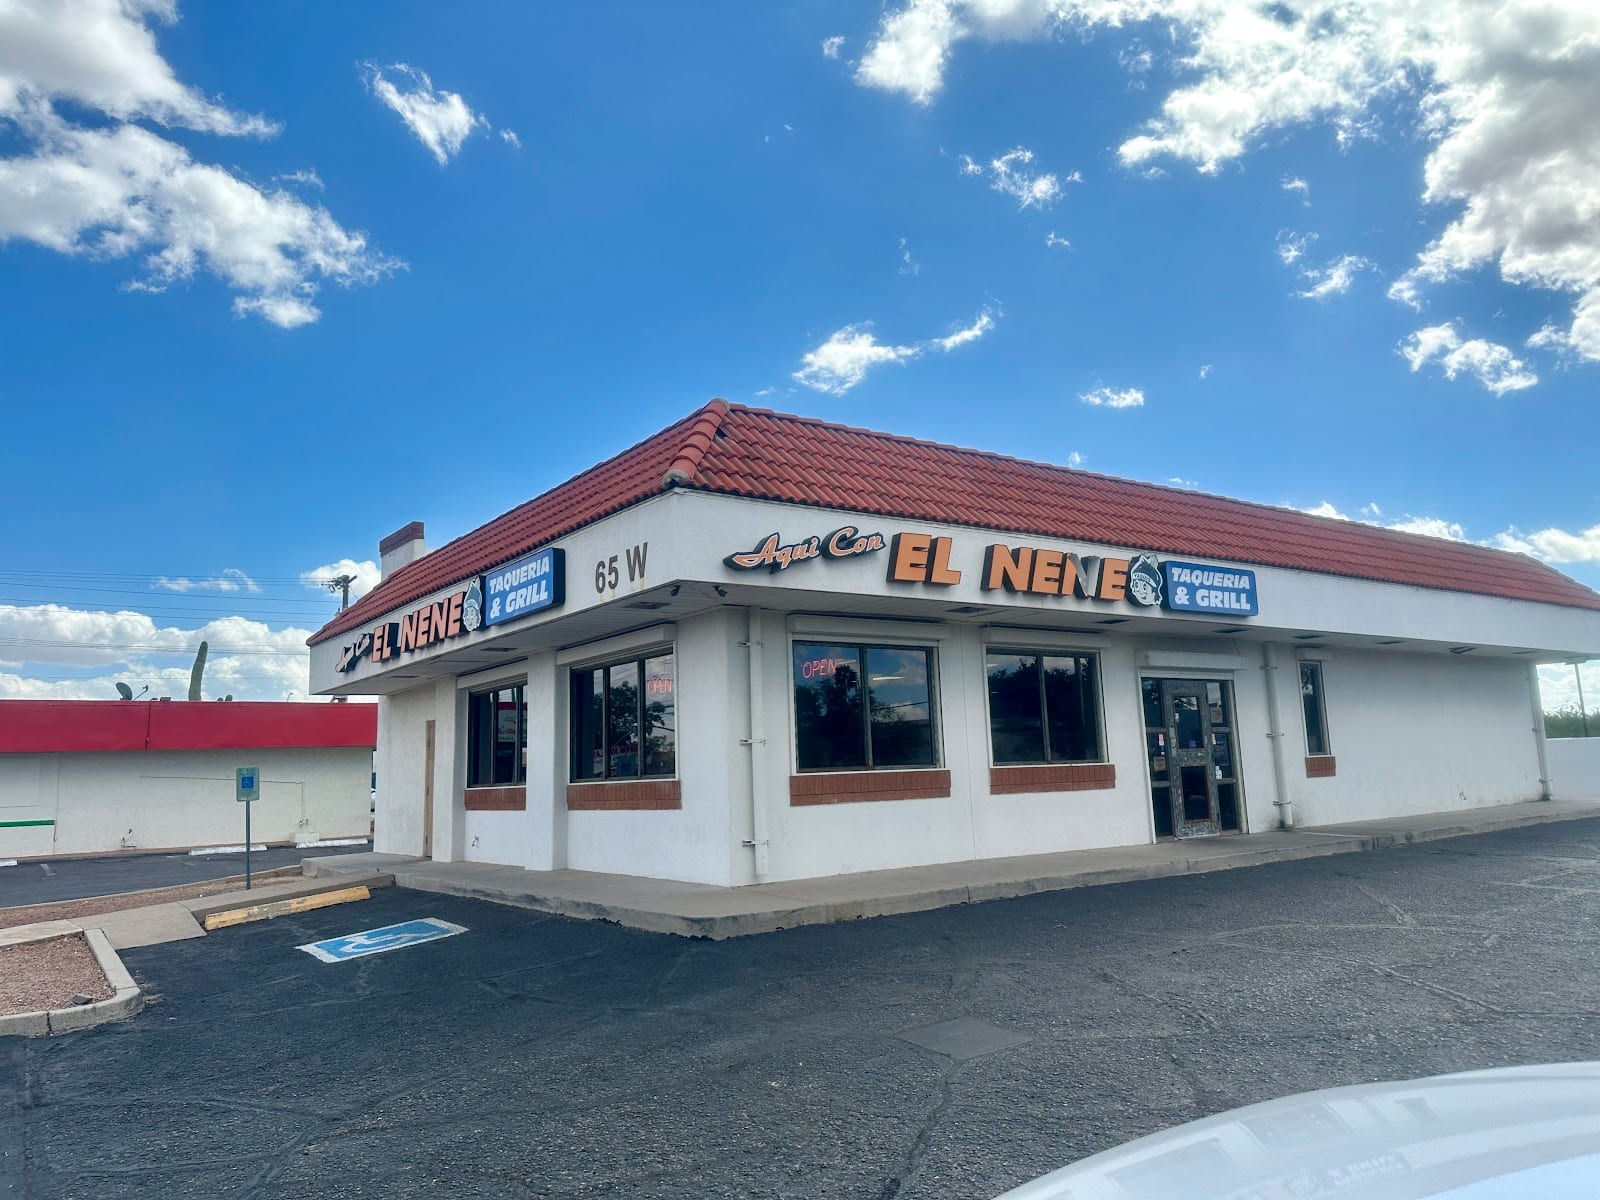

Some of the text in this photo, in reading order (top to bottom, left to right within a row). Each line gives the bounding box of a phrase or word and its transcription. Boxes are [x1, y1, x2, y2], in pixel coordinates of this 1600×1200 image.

[489, 556, 550, 595] TAQUERIA
[595, 541, 648, 594] 65 W
[826, 526, 885, 558] Con
[892, 531, 962, 585] EL
[986, 543, 1130, 601] NENE
[1171, 567, 1250, 590] TAQUERIA
[489, 579, 549, 619] & GRILL
[1174, 586, 1251, 610] & GRILL
[371, 623, 392, 663] EL
[400, 592, 464, 653] NENE
[646, 678, 672, 695] OPEN
[802, 657, 837, 679] OPEN
